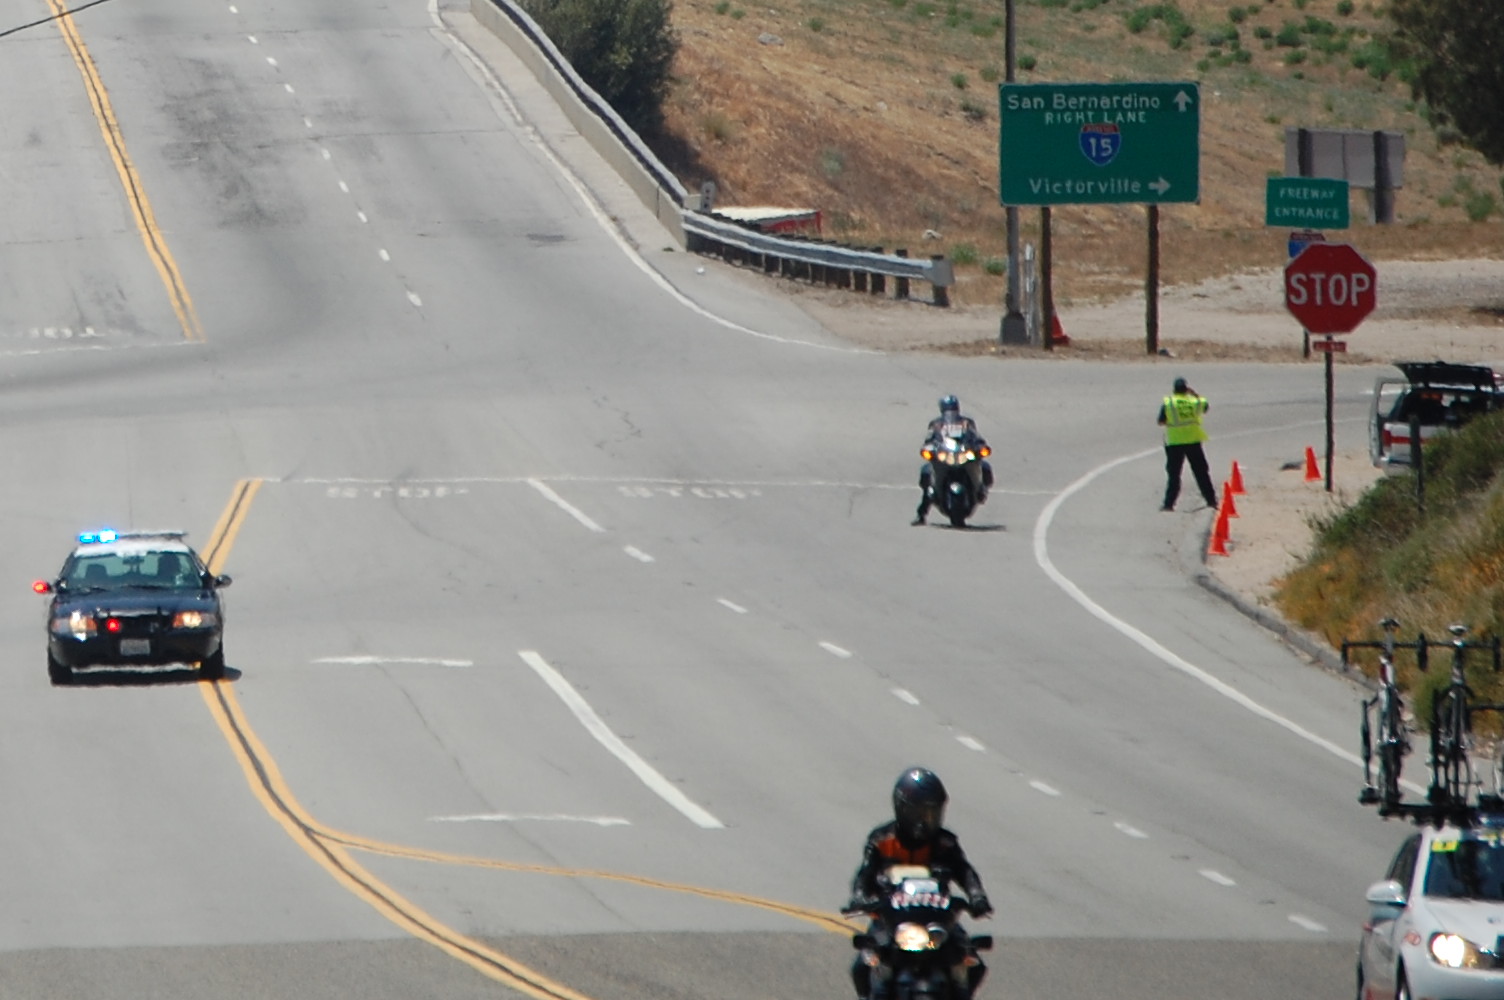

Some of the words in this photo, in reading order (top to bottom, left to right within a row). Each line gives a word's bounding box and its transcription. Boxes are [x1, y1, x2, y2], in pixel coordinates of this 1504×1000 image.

[1007, 94, 1044, 109] San
[1053, 93, 1161, 109] Bernardino
[1045, 111, 1095, 125] RIGHT
[1103, 111, 1147, 124] LANE
[1088, 137, 1113, 157] 15
[1028, 177, 1142, 194] Victorville
[1279, 187, 1336, 200] FREEWAY
[1274, 207, 1340, 220] ENTRANCE
[1289, 273, 1370, 307] STOP
